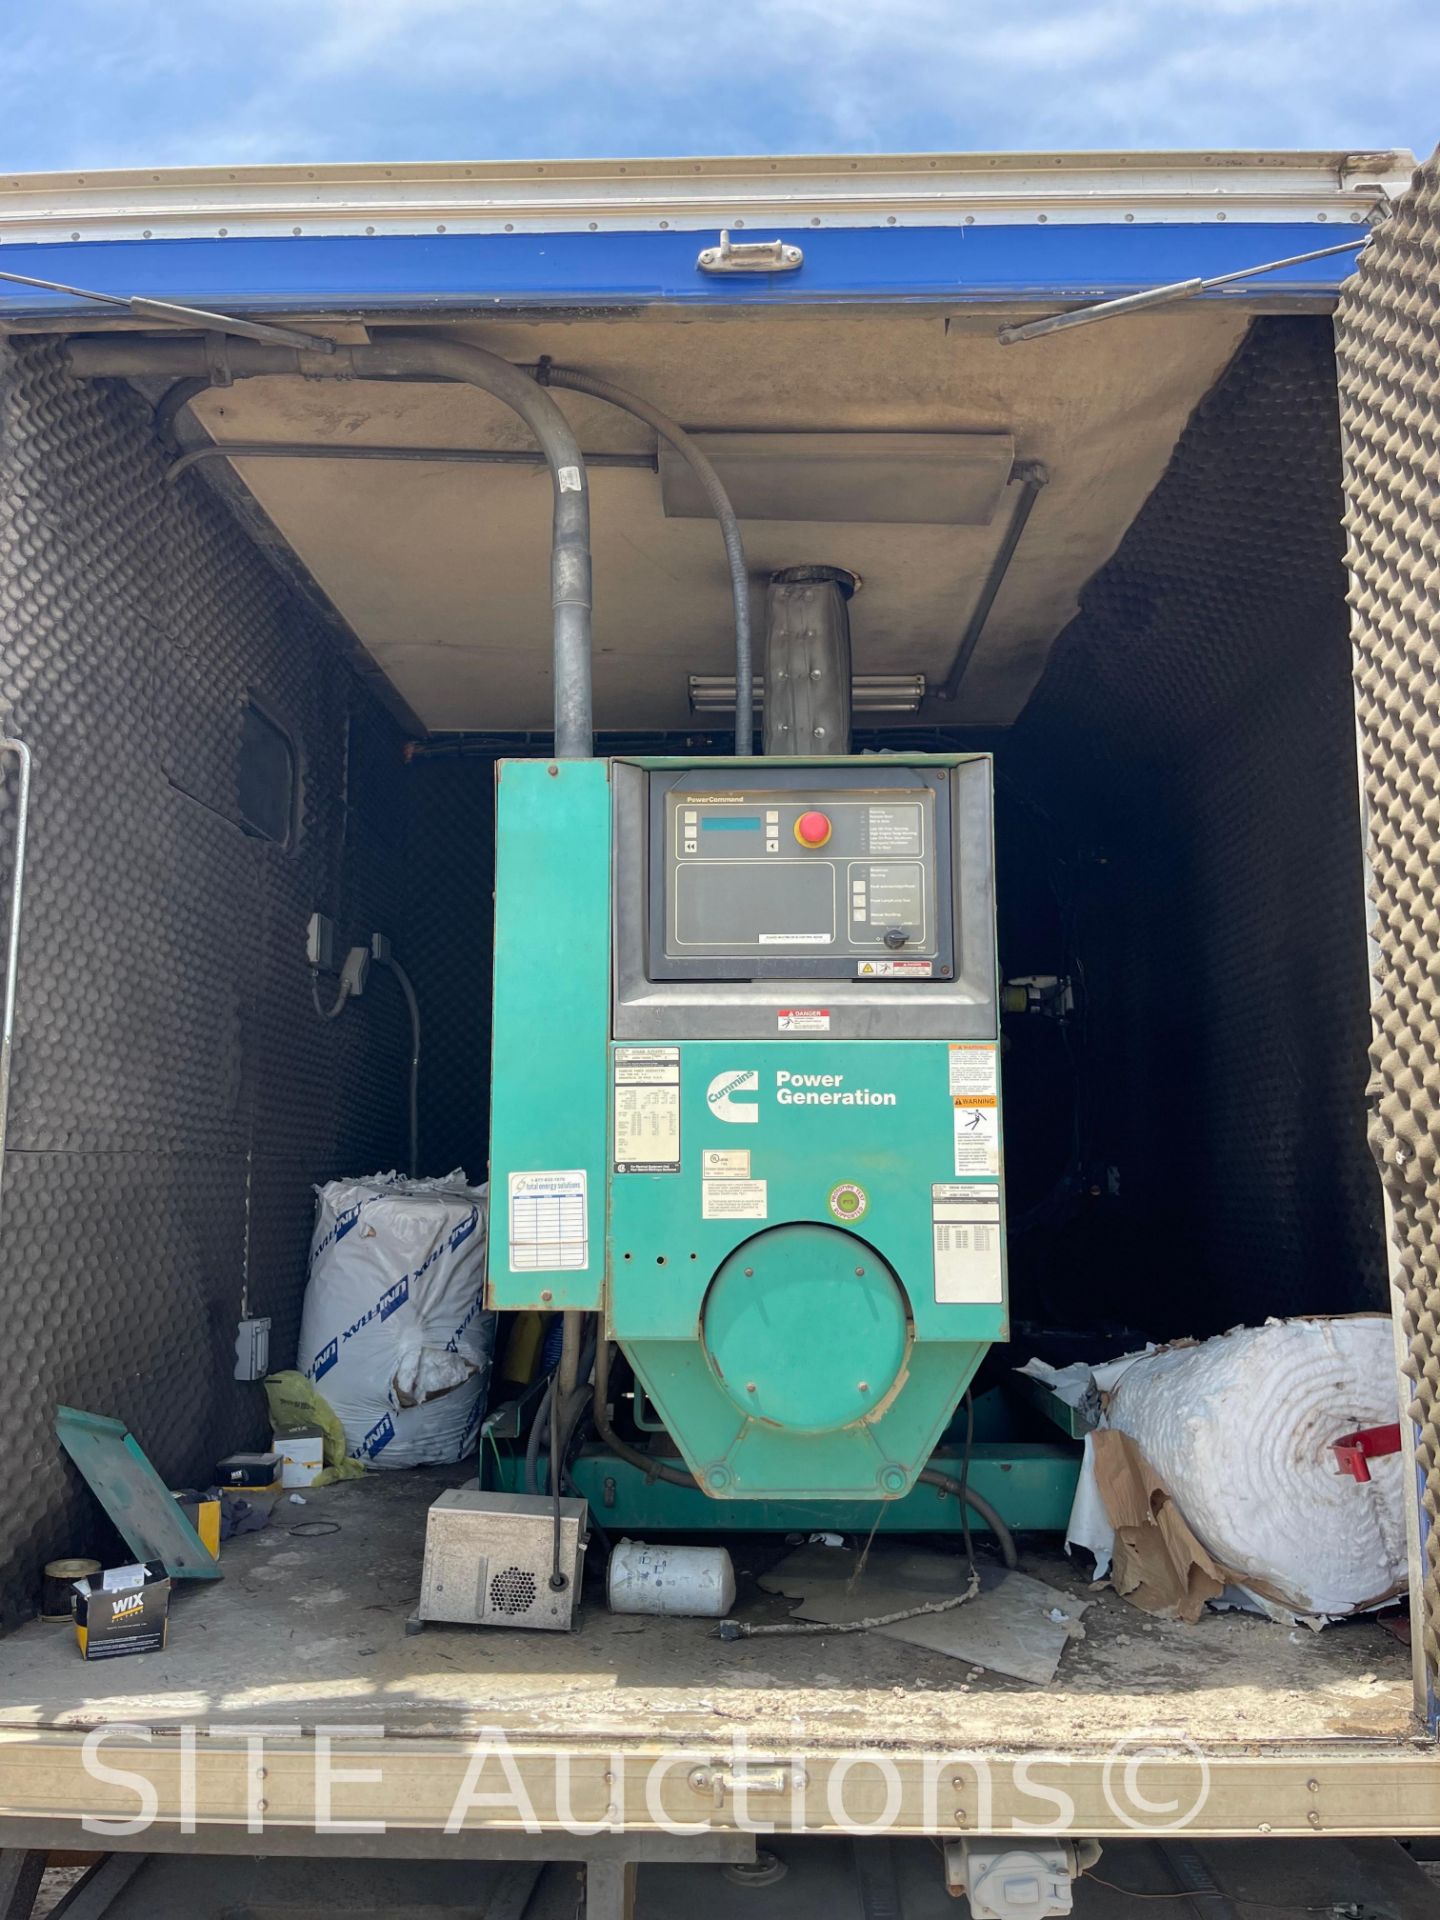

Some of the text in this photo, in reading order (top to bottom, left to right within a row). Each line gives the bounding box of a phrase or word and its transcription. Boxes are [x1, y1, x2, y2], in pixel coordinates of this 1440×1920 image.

[708, 1071, 754, 1104] Cummins
[776, 1070, 844, 1087] Power
[776, 1088, 897, 1106] Generation
[342, 1276, 409, 1343] UNIFRAX
[112, 1592, 144, 1614] WIX
